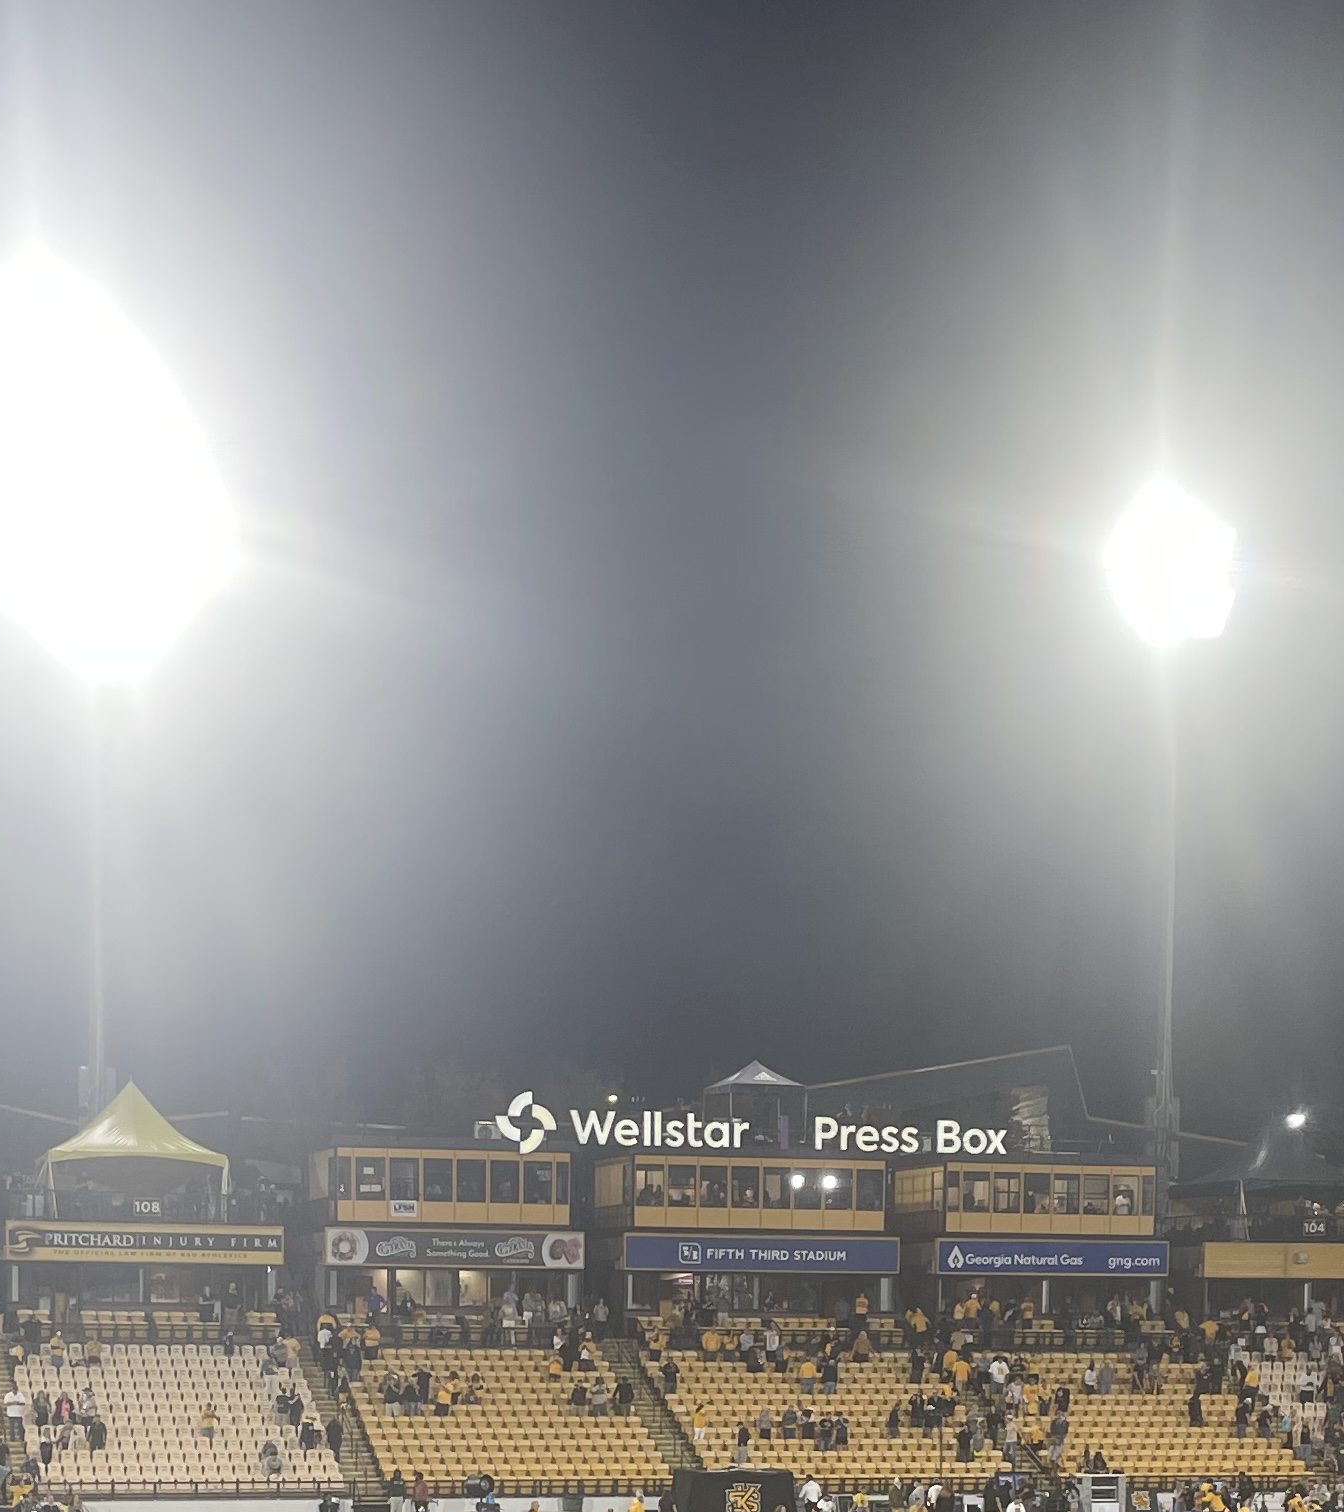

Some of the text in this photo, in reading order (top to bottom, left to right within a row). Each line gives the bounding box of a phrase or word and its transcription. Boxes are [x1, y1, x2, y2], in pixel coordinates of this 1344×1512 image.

[569, 1109, 1007, 1155] Wellstar Press Box
[134, 1201, 160, 1214] 108
[1303, 1222, 1325, 1235] 104
[44, 1233, 278, 1249] PRITCHARD INJURY FIRM
[459, 1239, 485, 1250] Always
[426, 1248, 468, 1259] Something
[706, 1247, 847, 1262] FIFTH THIRD STADIUM
[965, 1253, 1161, 1270] Georgia Natural Gas gng.com
